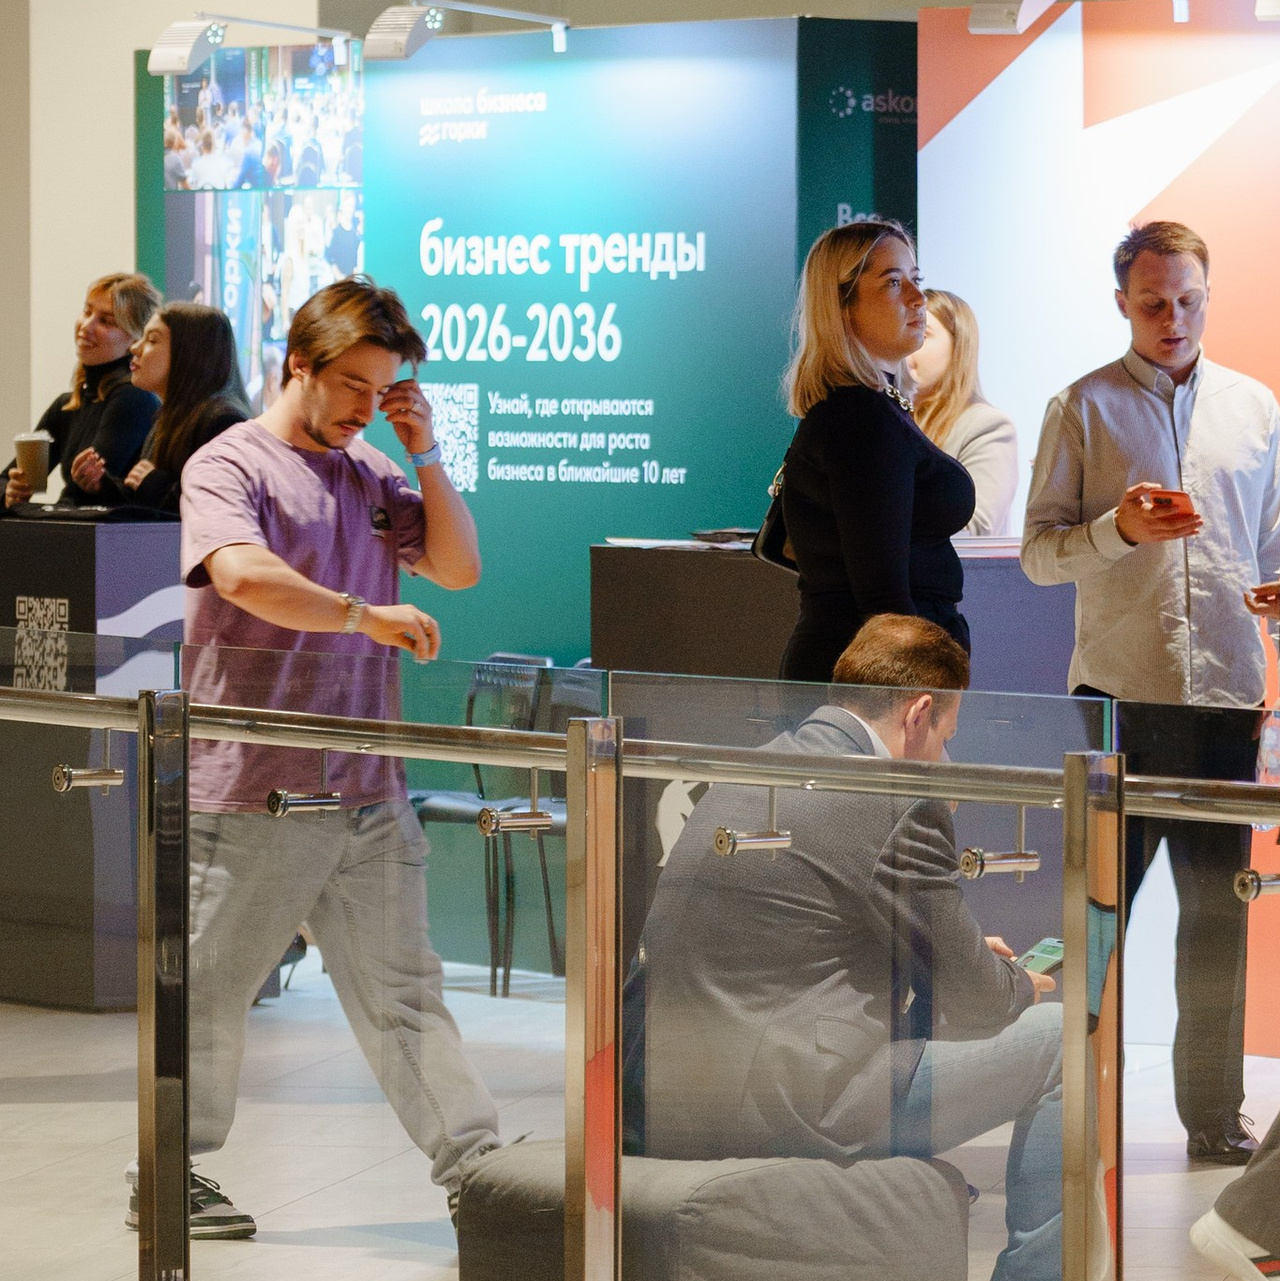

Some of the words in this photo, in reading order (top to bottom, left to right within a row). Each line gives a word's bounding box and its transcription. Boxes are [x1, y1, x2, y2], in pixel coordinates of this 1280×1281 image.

[476, 87, 547, 114] бизнеса
[420, 217, 551, 276] бизнес
[559, 231, 706, 292] тренды
[420, 302, 623, 362] 2026-2036
[487, 391, 532, 418] Узнай,
[535, 399, 558, 417] где
[561, 397, 654, 421] открываются
[488, 430, 577, 449] возможности
[579, 432, 605, 451] для
[608, 431, 650, 455] роста
[487, 457, 544, 481] бизнеса
[547, 465, 556, 482] в
[558, 458, 639, 484] ближайшие
[642, 460, 659, 484] 10
[661, 467, 687, 485] лет
